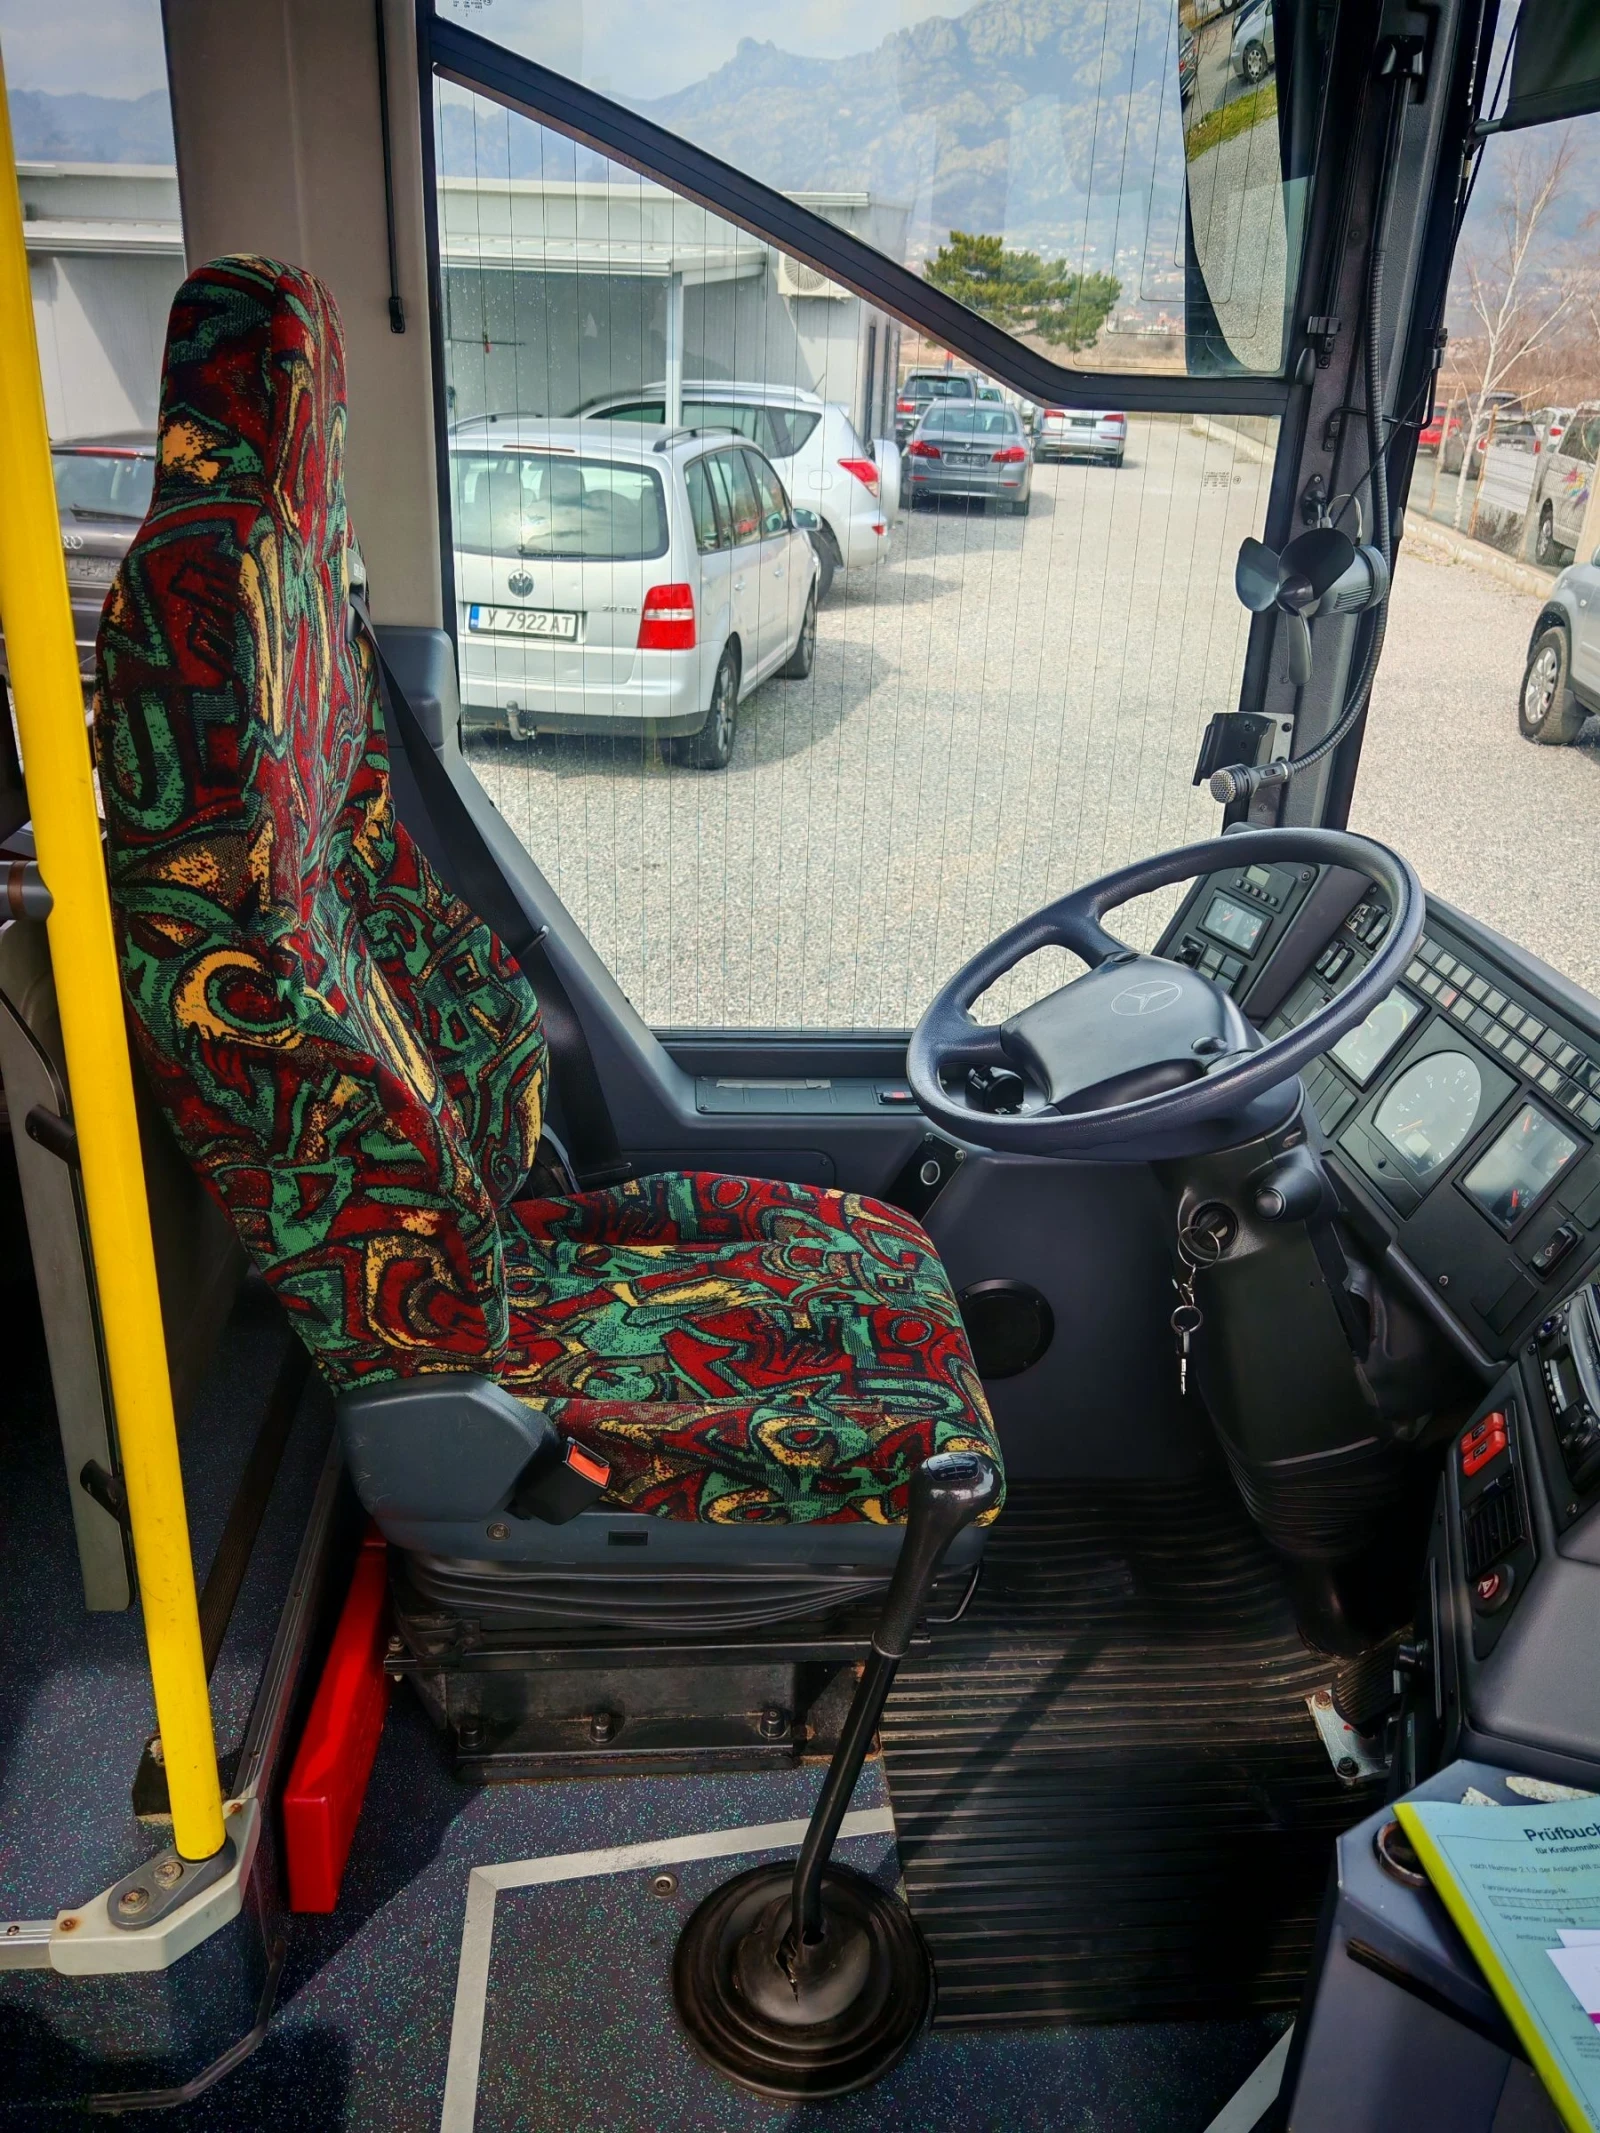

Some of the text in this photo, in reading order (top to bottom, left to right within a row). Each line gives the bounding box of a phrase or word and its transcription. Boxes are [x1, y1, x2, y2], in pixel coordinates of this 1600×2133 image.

[506, 612, 548, 632] 7922
[550, 616, 574, 634] AT
[1535, 1846, 1548, 1854] für
